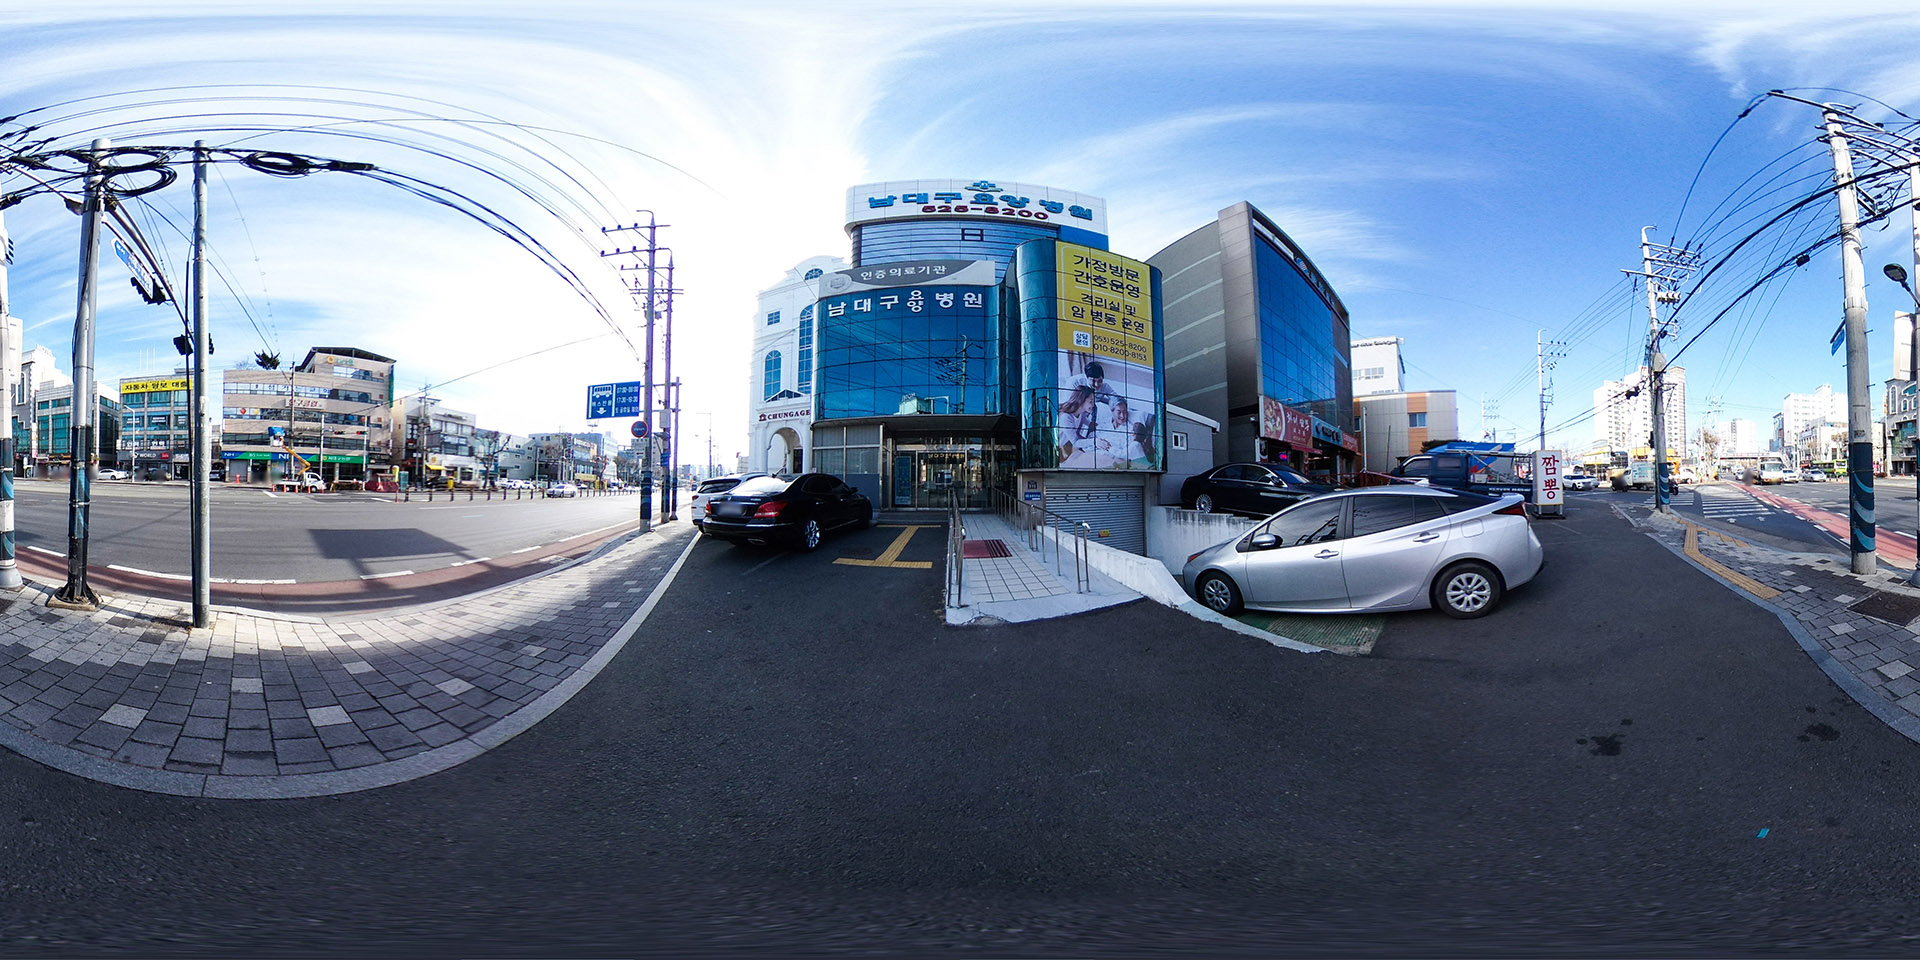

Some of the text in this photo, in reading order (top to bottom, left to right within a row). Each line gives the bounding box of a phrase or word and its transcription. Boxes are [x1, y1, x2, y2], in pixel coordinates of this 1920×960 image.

[921, 205, 1049, 220] 525-8200
[1073, 254, 1140, 283] 가정방문
[1073, 269, 1140, 299] 간호운영
[1081, 293, 1120, 312] 격리실
[1071, 305, 1085, 319] 암
[1121, 317, 1145, 334] 운영
[1541, 454, 1560, 500] 짬뽕
